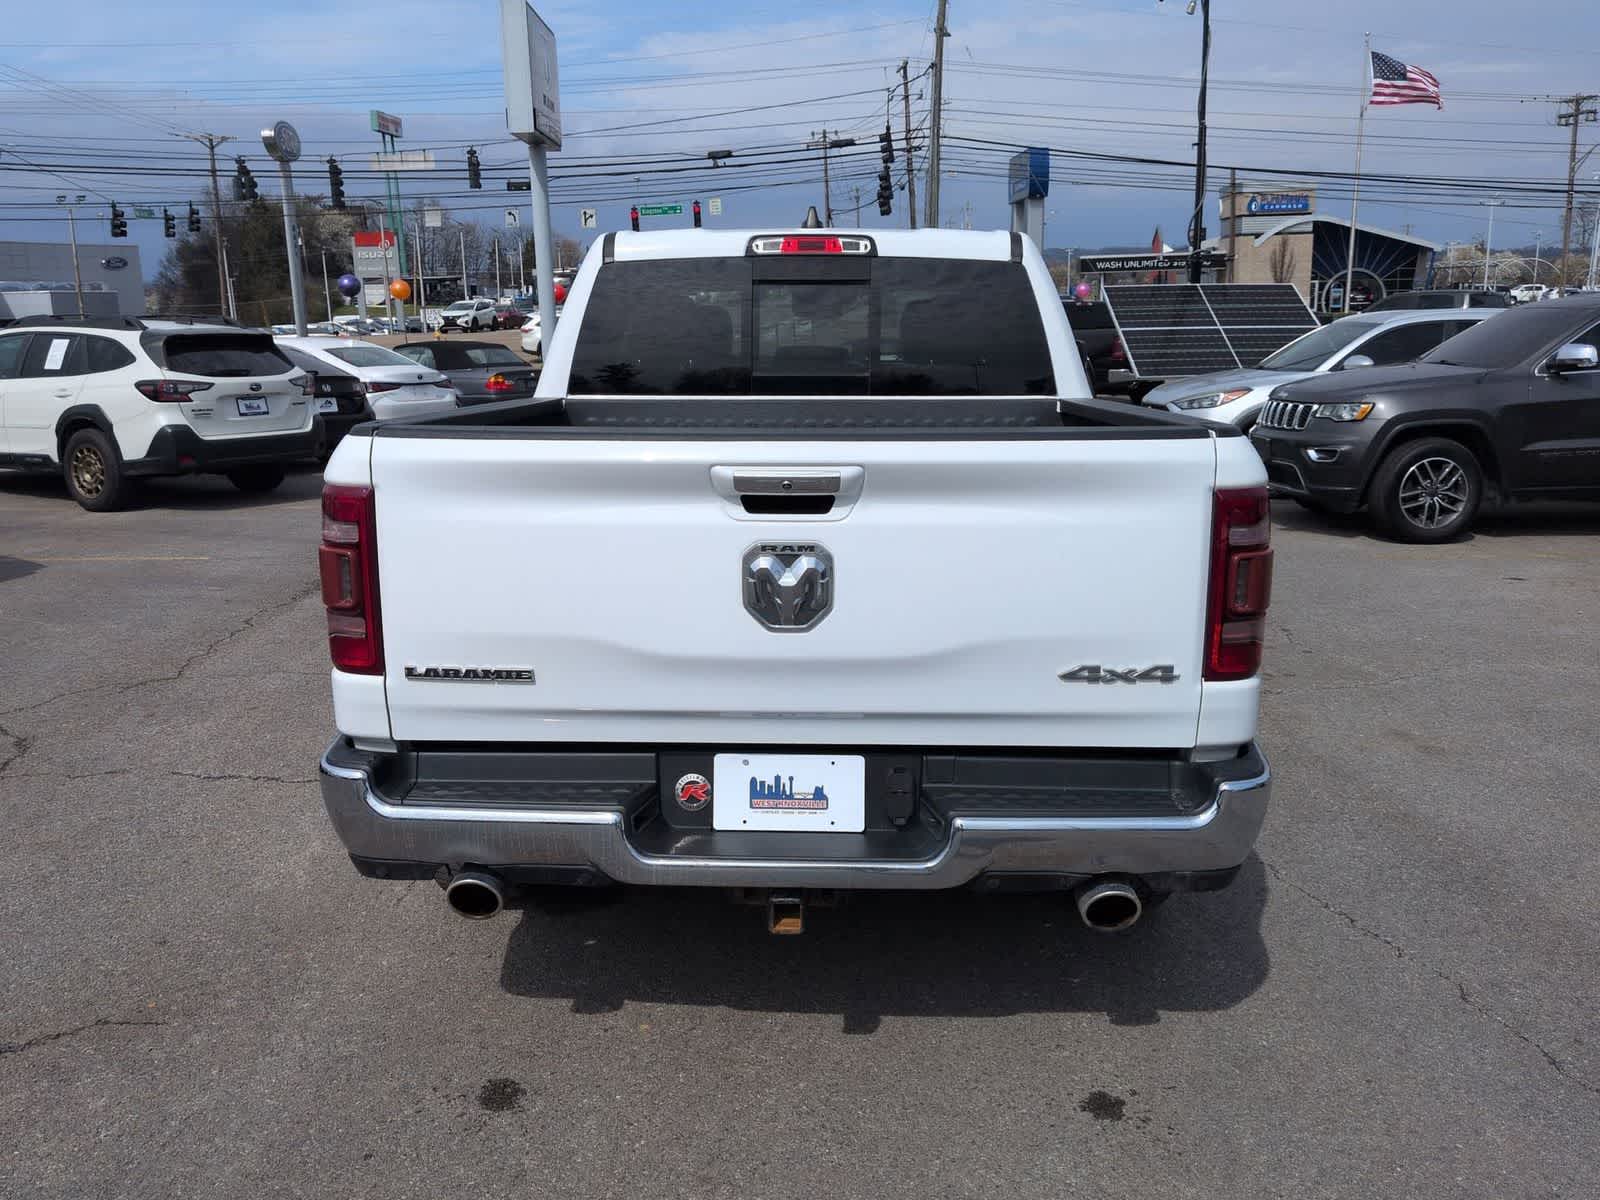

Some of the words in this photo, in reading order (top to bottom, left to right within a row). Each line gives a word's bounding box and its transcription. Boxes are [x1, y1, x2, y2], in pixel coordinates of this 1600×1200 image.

[1096, 261, 1122, 269] WASH
[1123, 259, 1170, 269] UNLIMITED
[405, 667, 535, 683] LARAMIE
[1057, 665, 1181, 684] 4x4
[778, 800, 825, 808] KNOXVILLE
